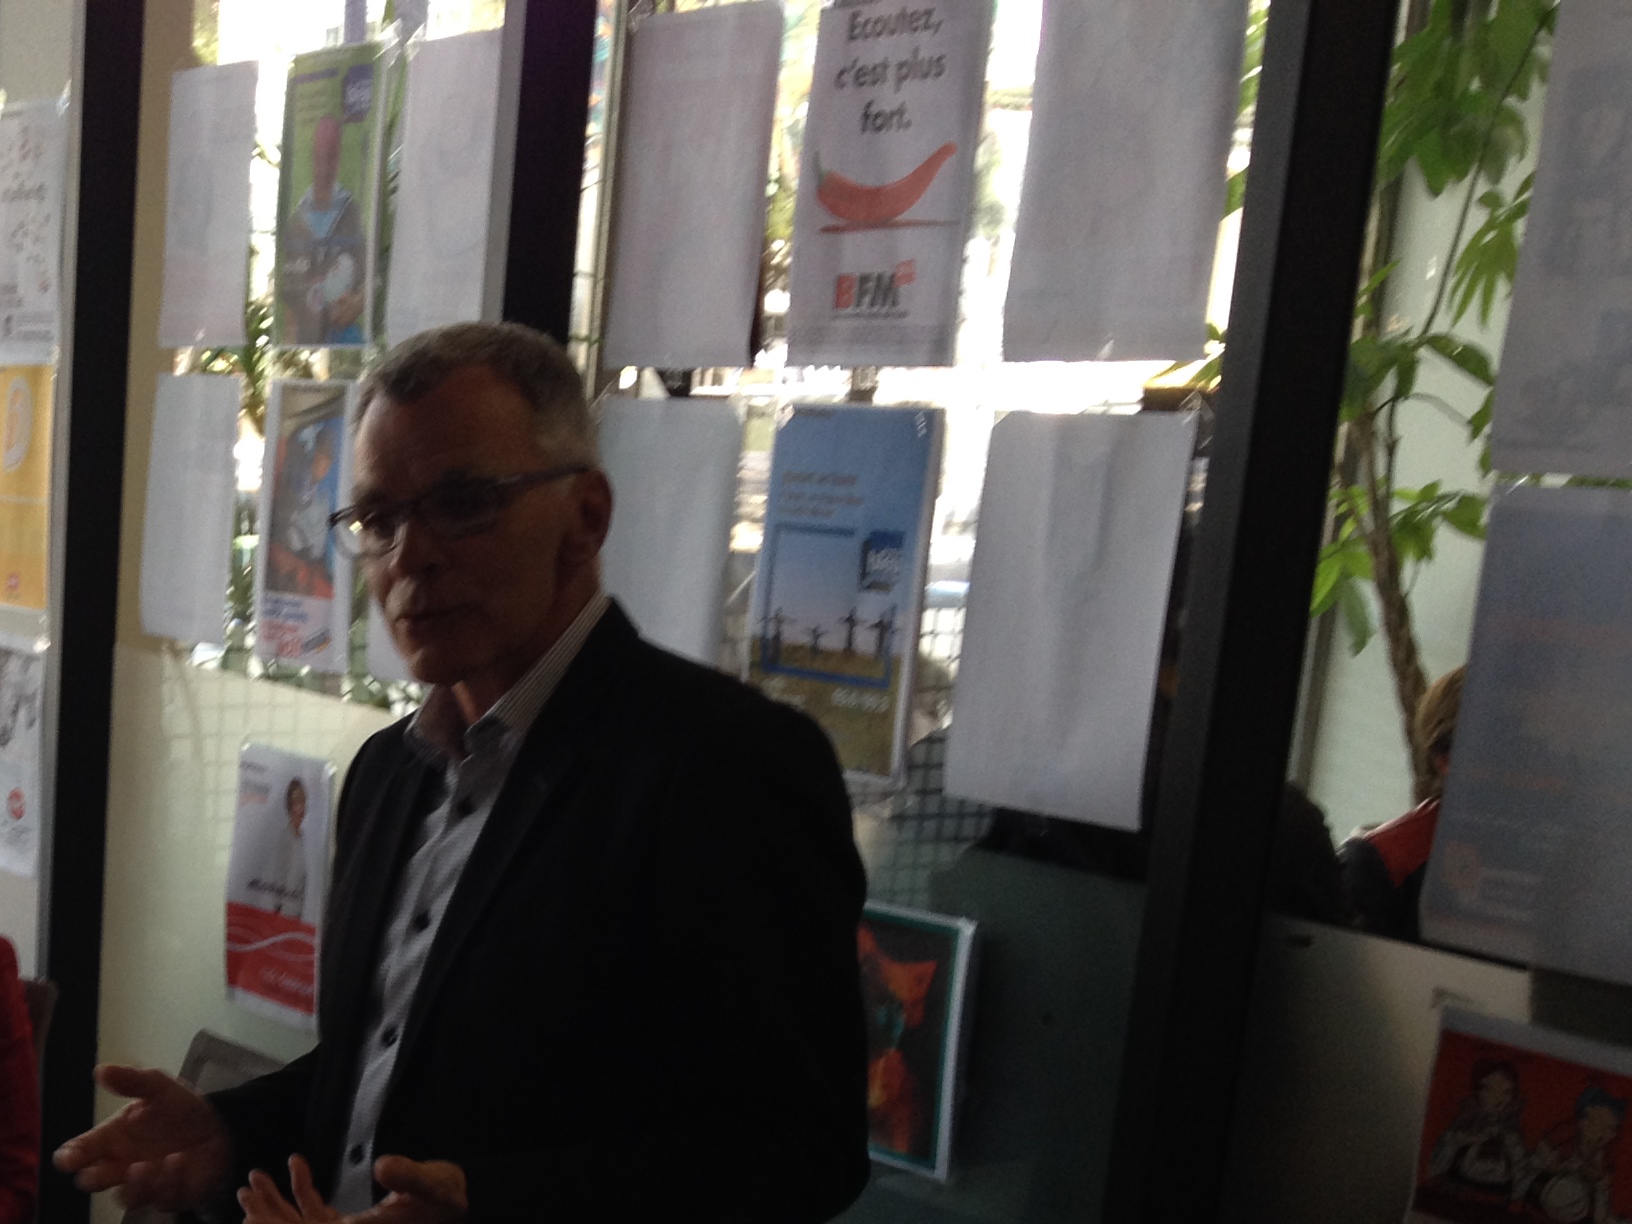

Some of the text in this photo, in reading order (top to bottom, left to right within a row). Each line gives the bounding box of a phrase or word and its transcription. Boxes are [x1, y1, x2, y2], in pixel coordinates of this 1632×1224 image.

[834, 45, 946, 94] c'est plus
[834, 272, 900, 309] BFM
